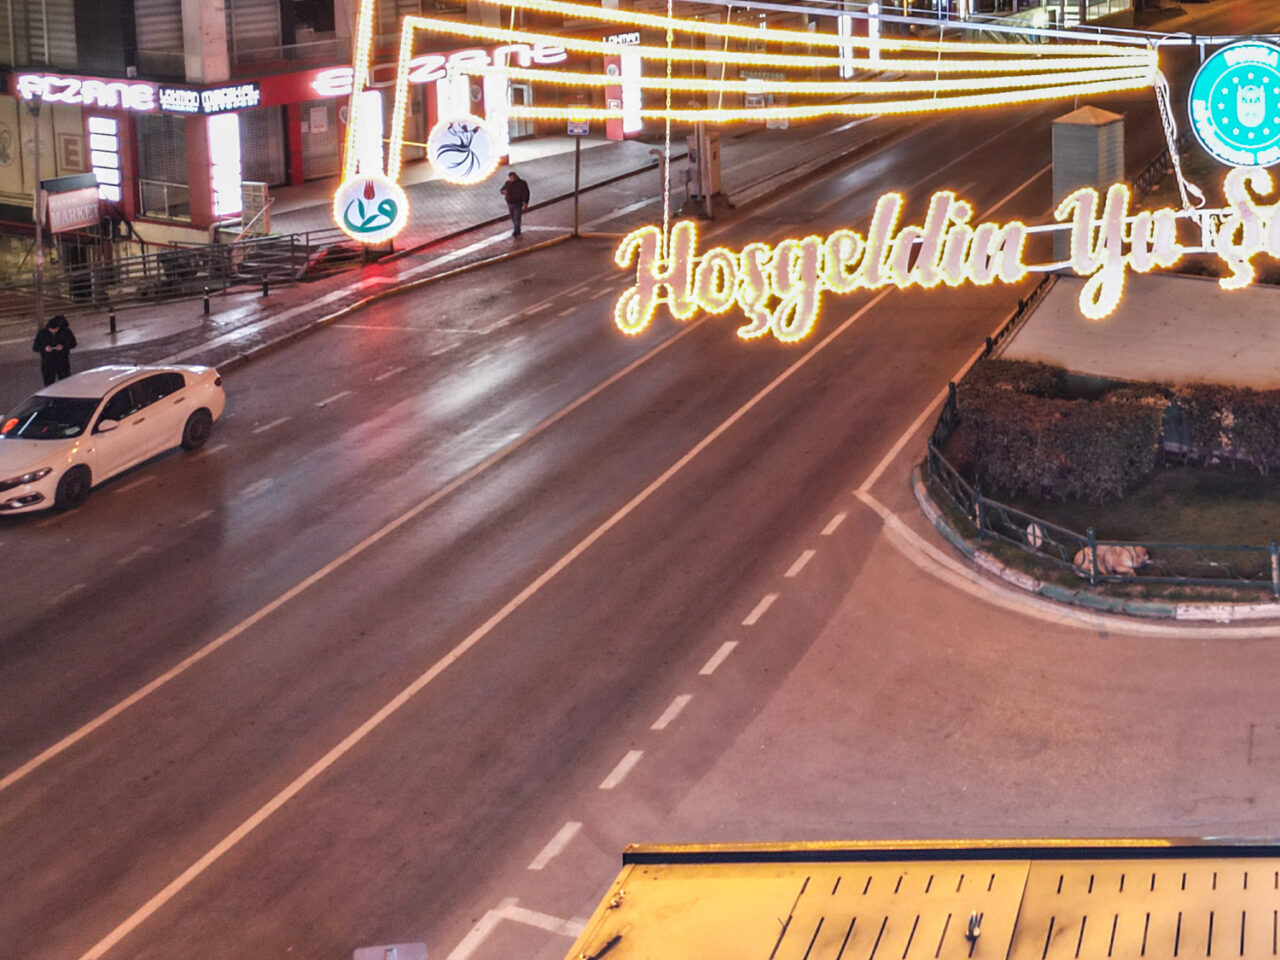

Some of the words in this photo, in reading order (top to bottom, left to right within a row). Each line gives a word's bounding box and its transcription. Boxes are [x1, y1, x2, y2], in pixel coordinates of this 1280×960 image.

[51, 203, 98, 224] MARKET
[614, 190, 1028, 343] Hoşgeldin
[1054, 183, 1184, 320] Ya
